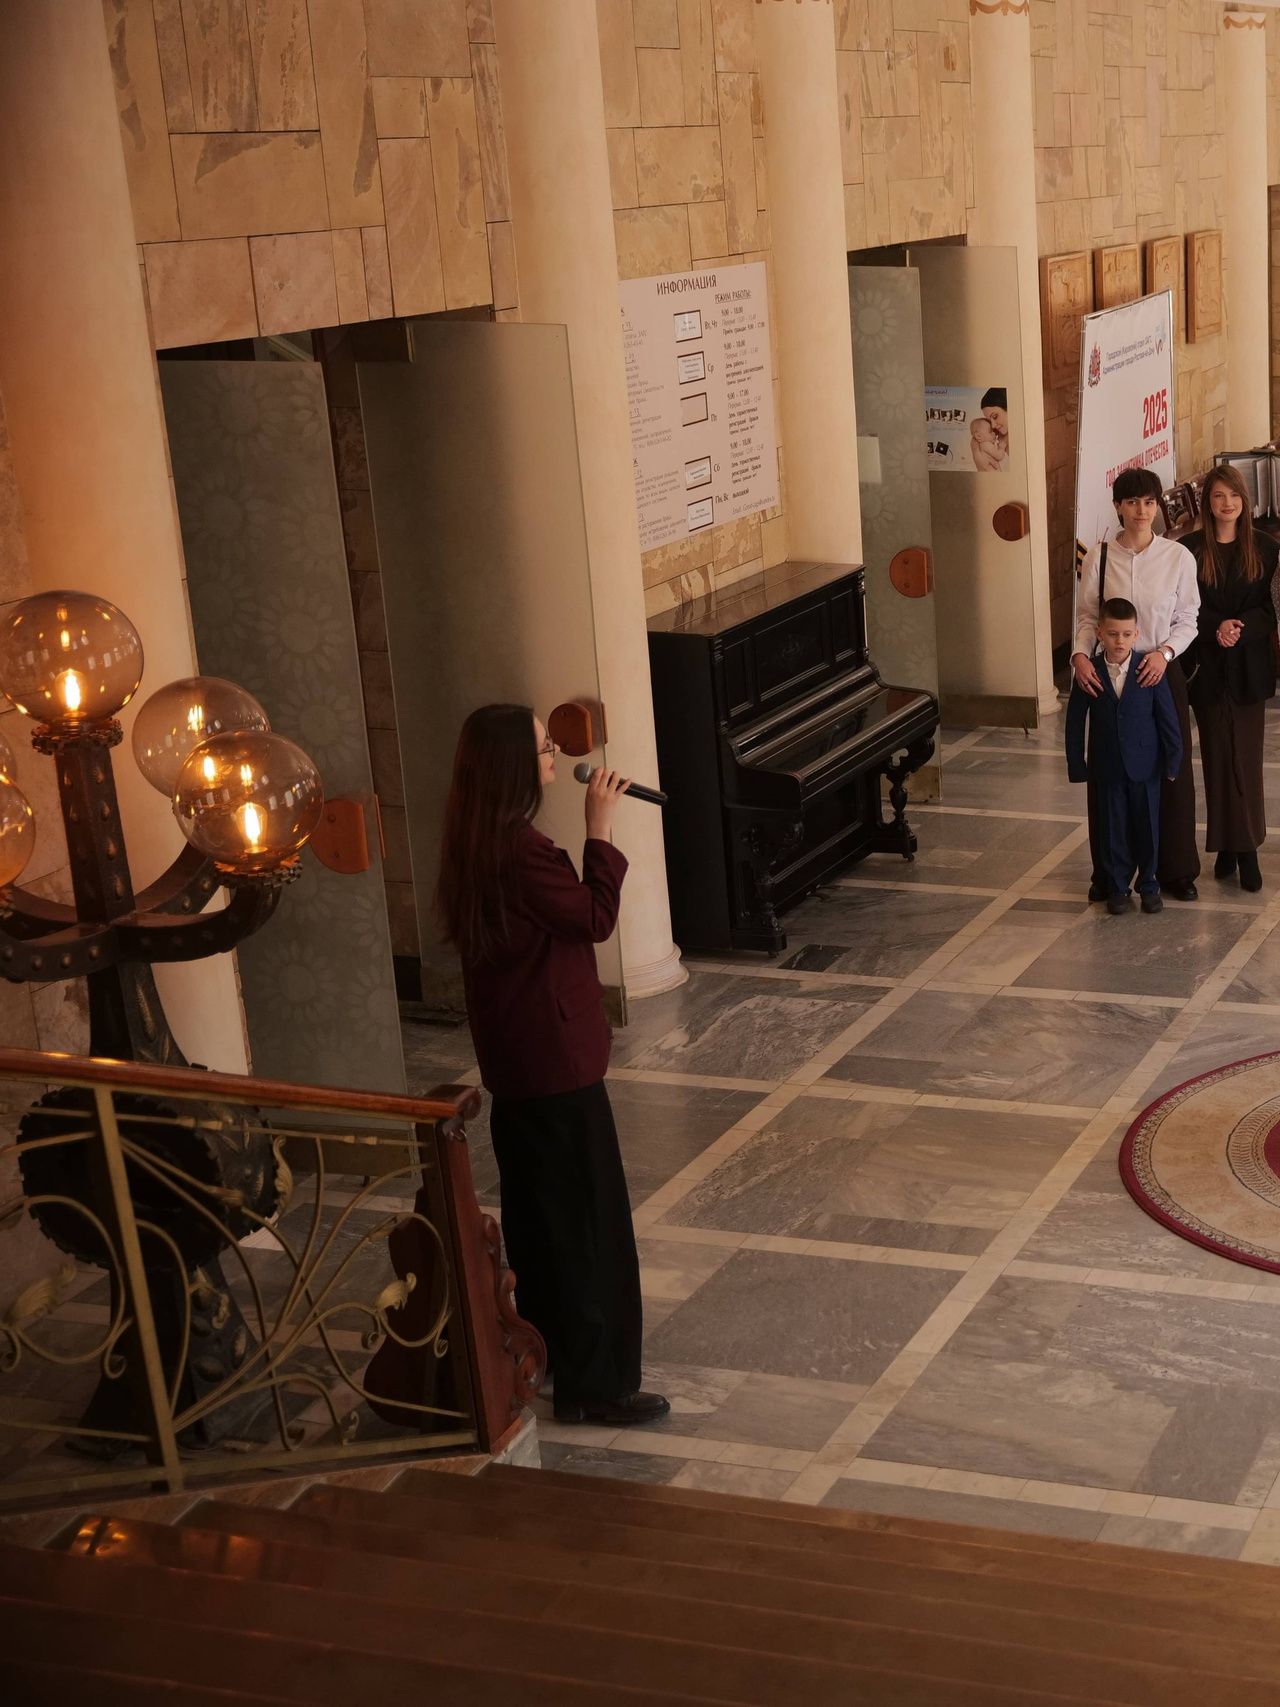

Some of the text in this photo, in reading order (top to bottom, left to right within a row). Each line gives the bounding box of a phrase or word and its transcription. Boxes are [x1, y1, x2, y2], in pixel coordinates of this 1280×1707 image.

[656, 274, 717, 296] ИНФОРМАЦИЯ
[715, 289, 751, 303] РЕЖИМ РАБОТЫ:
[707, 363, 714, 374] Ср
[711, 413, 717, 422] Пт
[1143, 388, 1168, 439] 2025
[1145, 439, 1169, 467] ОТЕЧЕСТВА
[713, 462, 720, 472] Сб
[715, 495, 723, 504] Пн,
[723, 493, 729, 501] Вс
